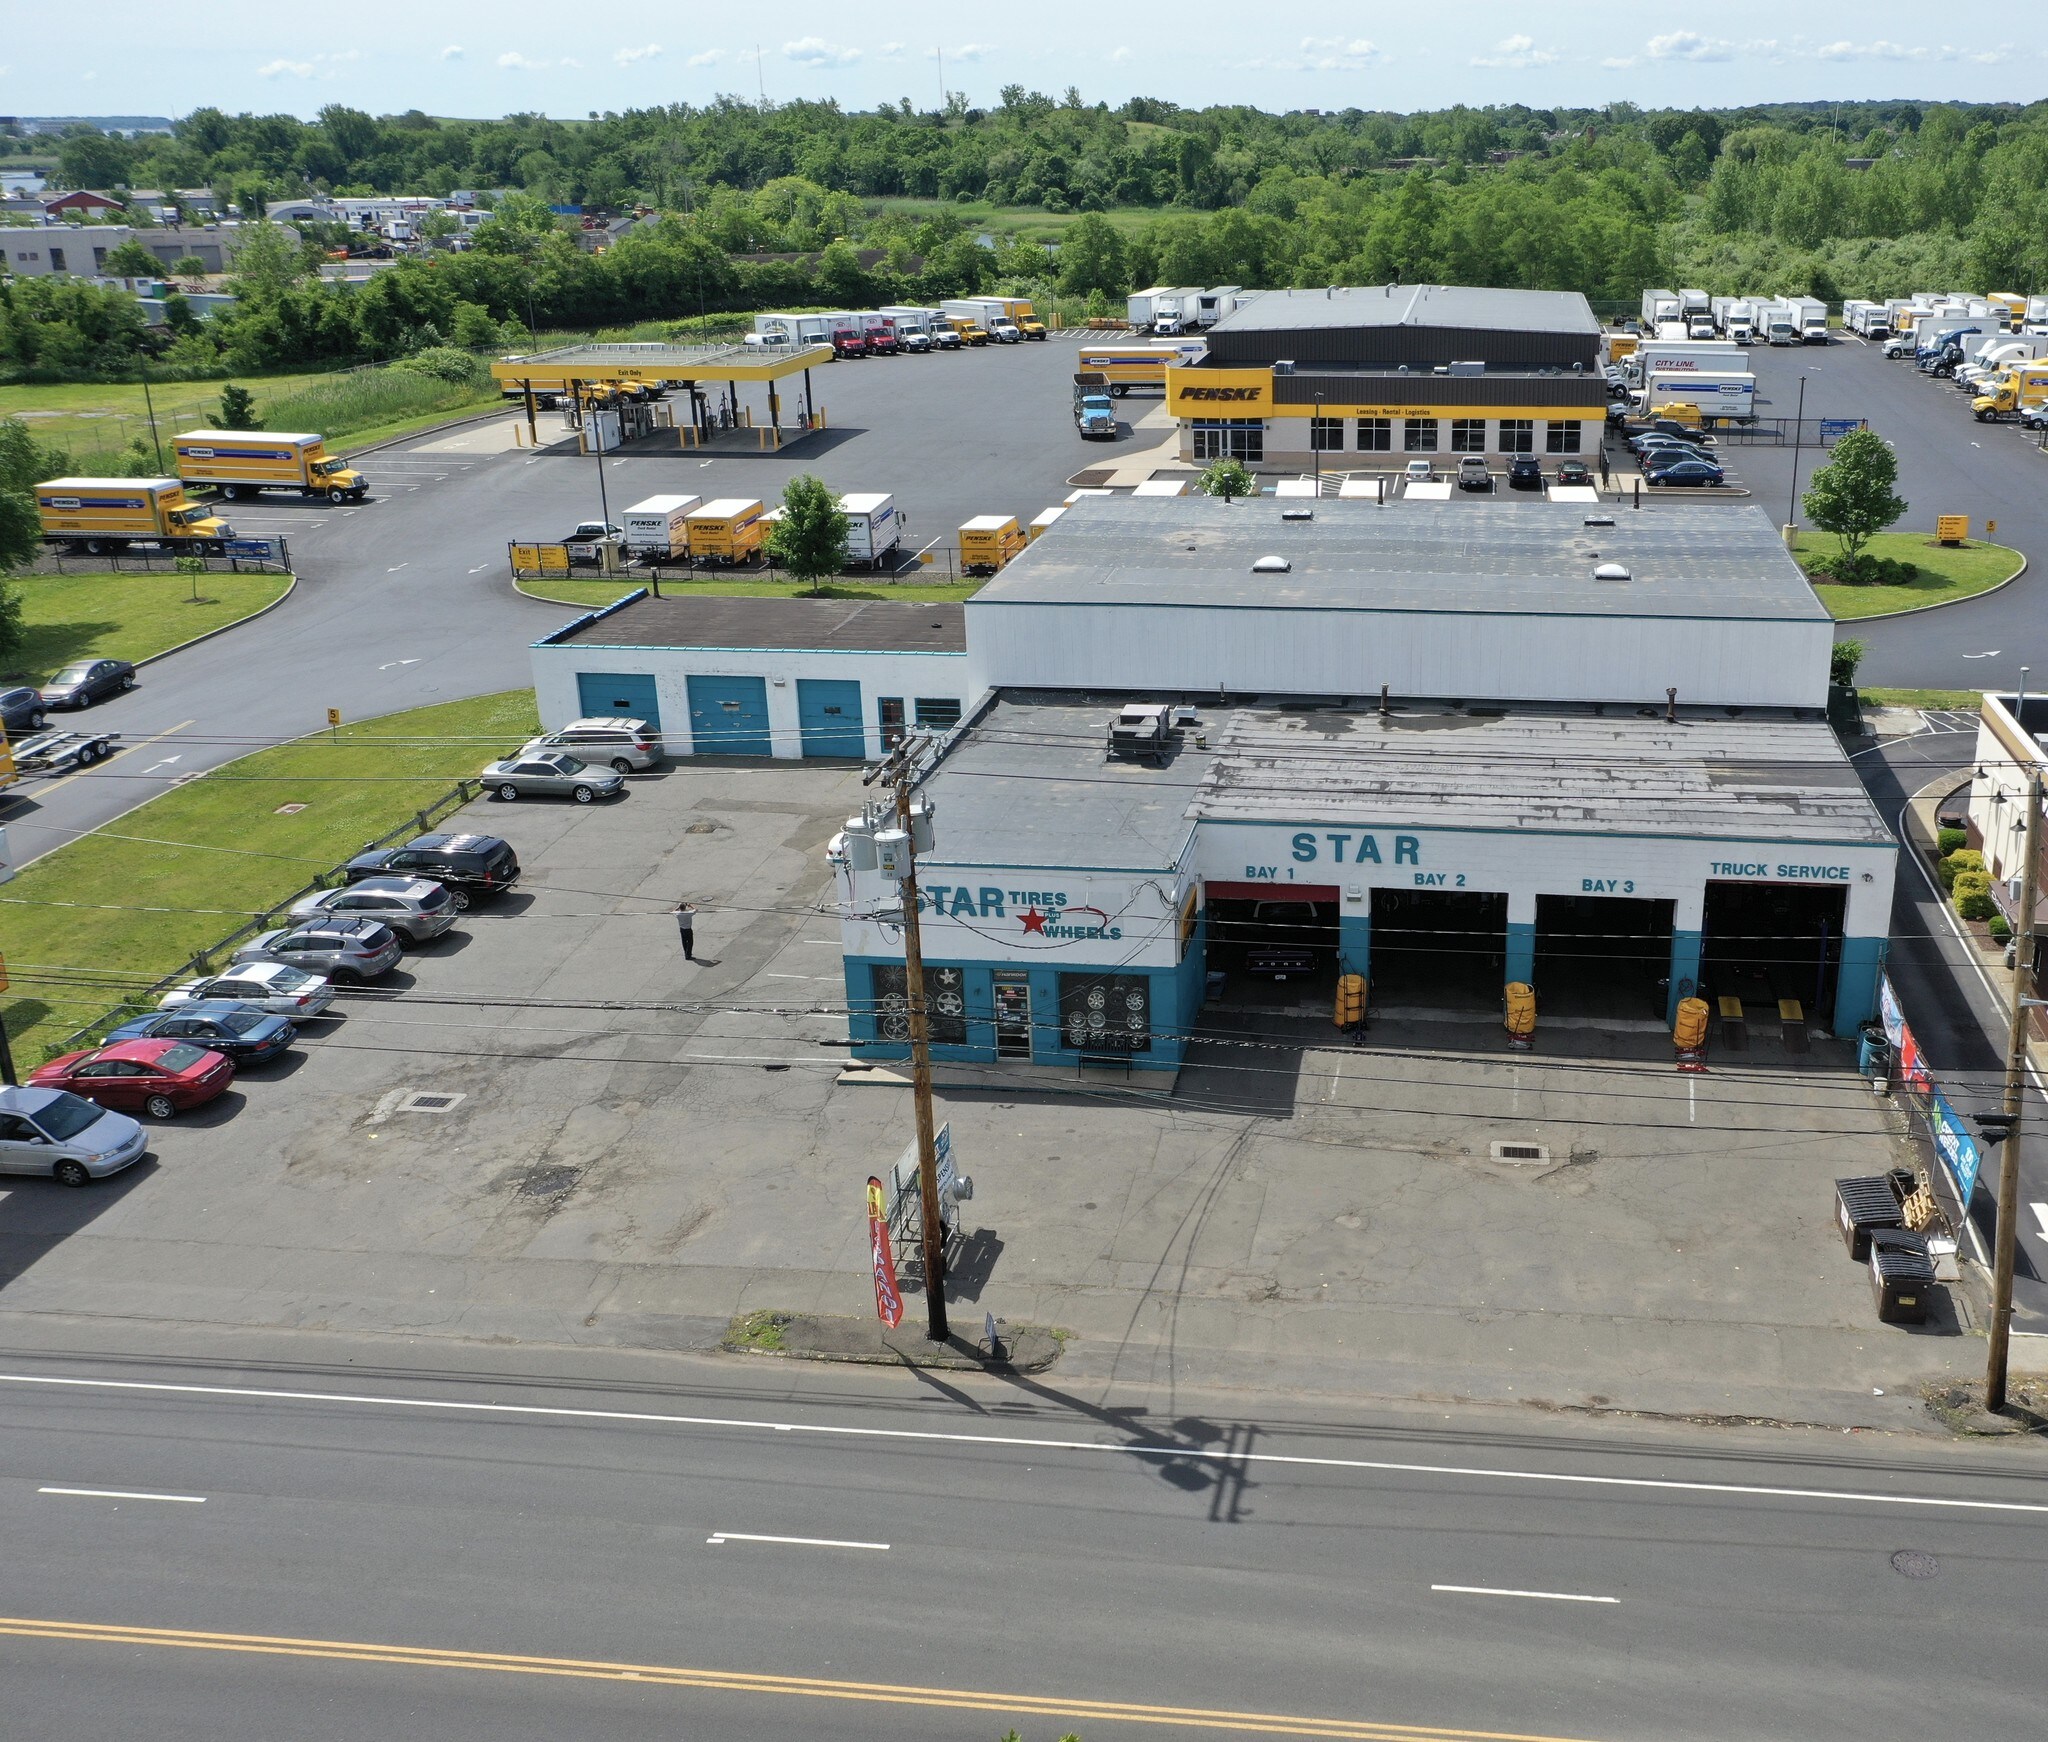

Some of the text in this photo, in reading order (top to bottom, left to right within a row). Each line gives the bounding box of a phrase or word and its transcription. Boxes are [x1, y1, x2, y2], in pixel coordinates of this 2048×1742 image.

[1178, 387, 1263, 401] PENSKE
[1356, 408, 1378, 416] Leasing
[1405, 408, 1431, 416] Logistics
[330, 709, 336, 719] 5
[1291, 832, 1420, 866] STAR
[1245, 865, 1294, 880] BAY 1
[1710, 862, 1850, 880] TRUCK SERVICE
[1414, 873, 1466, 887] BAY 2
[1582, 878, 1635, 894] BAY 3
[1008, 890, 1068, 907] TIRES
[1044, 911, 1061, 919] PLUS
[1042, 926, 1122, 941] WHEELS
